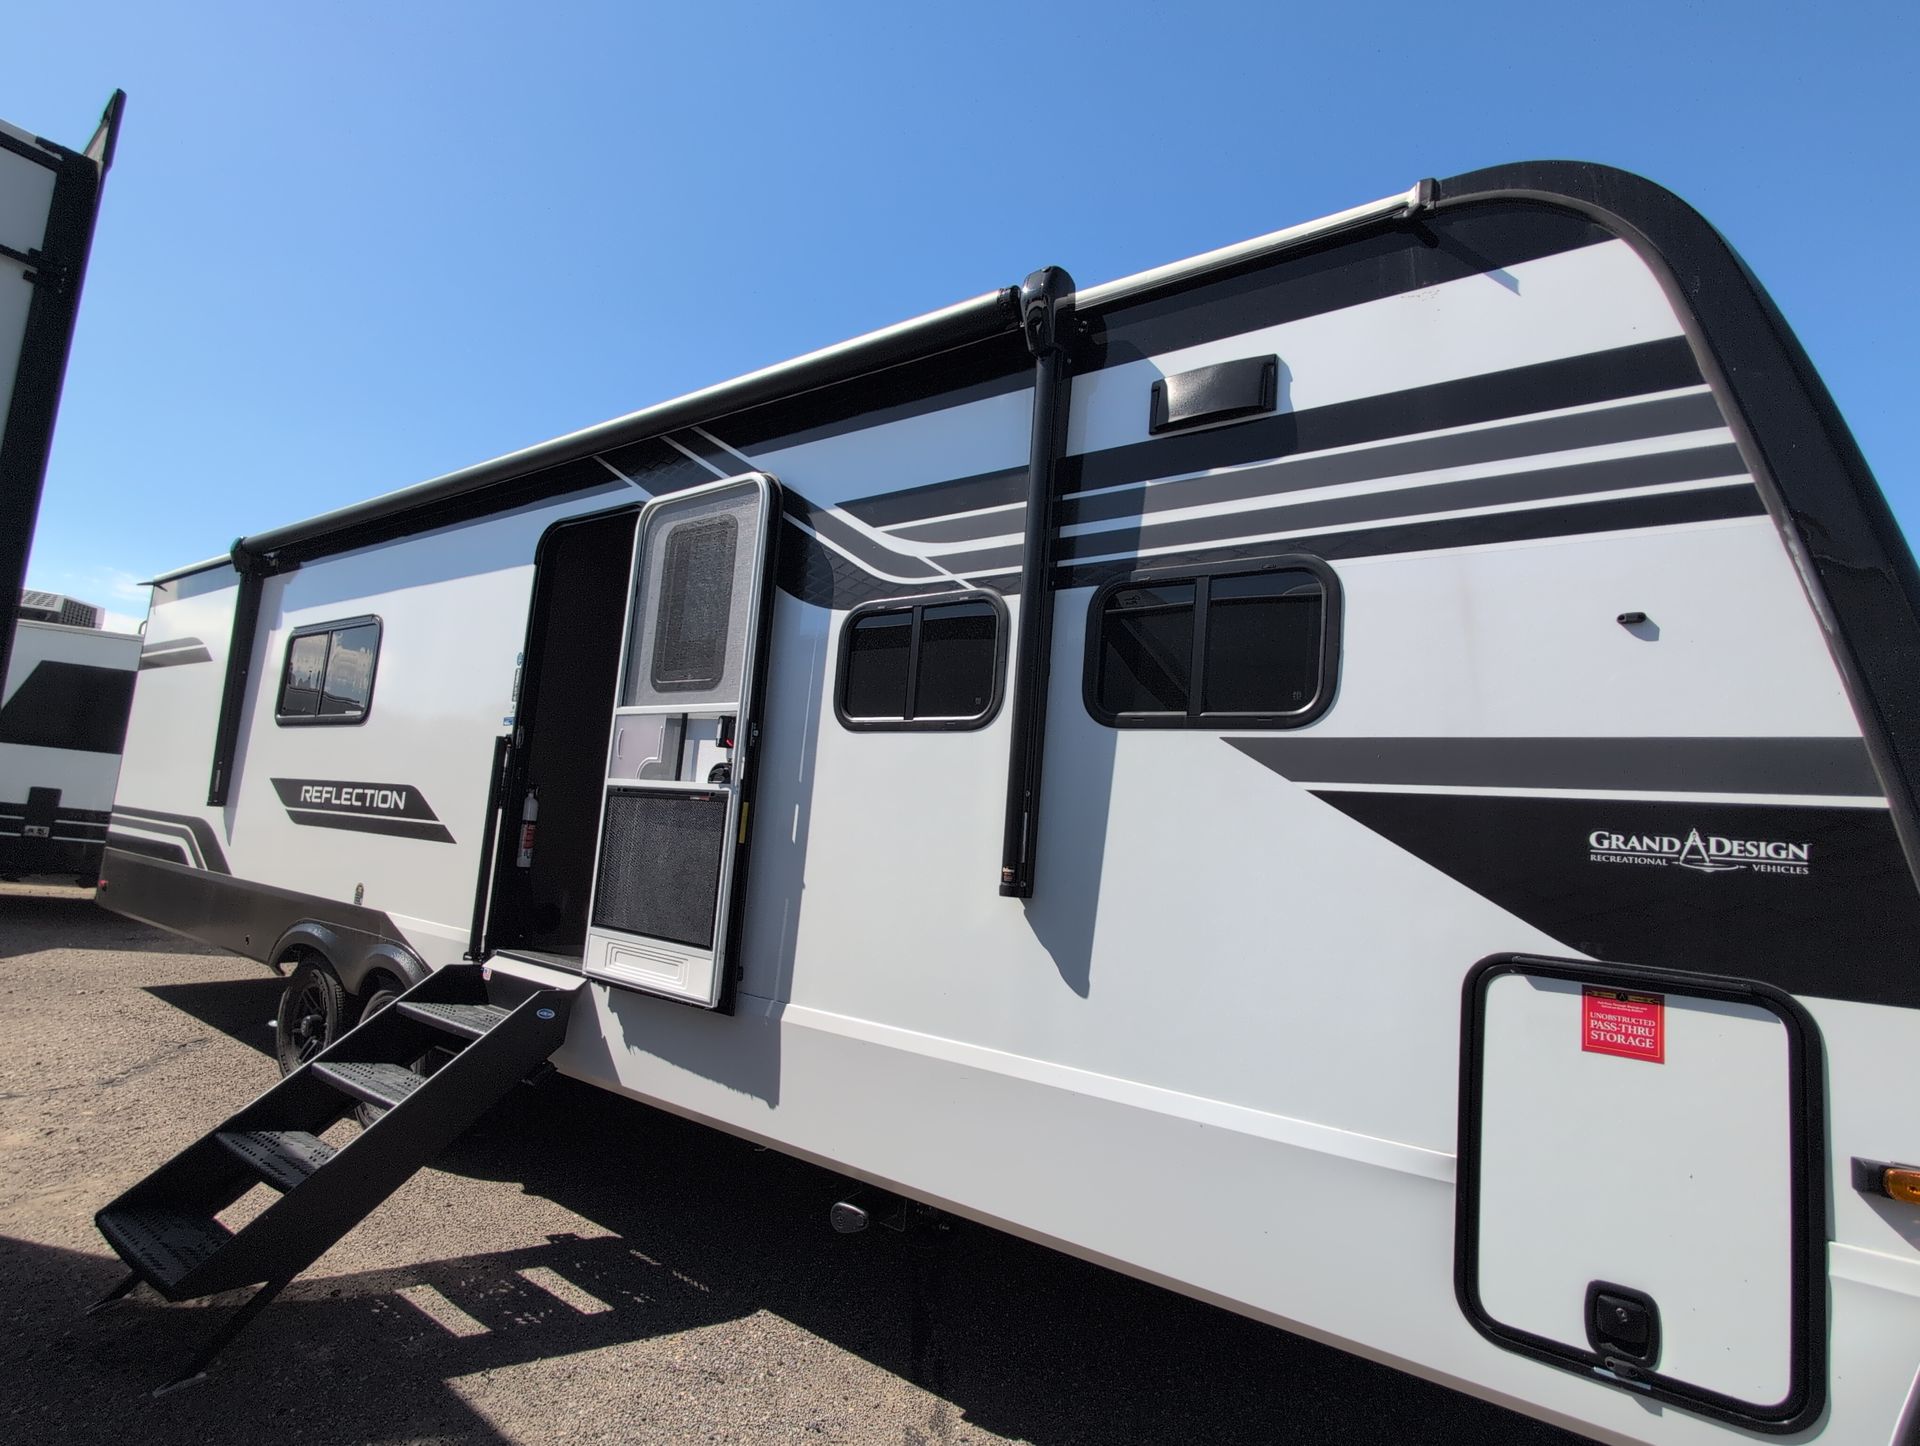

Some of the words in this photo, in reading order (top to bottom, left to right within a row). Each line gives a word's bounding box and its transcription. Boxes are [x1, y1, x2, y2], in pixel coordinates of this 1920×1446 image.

[300, 785, 406, 810] REFLECTION
[1589, 831, 1681, 853] GRAND
[1708, 836, 1809, 860] DESIGN
[1590, 854, 1669, 866] RECREATIONAL
[1753, 863, 1809, 875] VEHICLES
[1590, 1012, 1656, 1027] UNOBSTRUCTED
[1590, 1020, 1655, 1037] PASS-THRU
[1590, 1030, 1655, 1048] STORAGE
